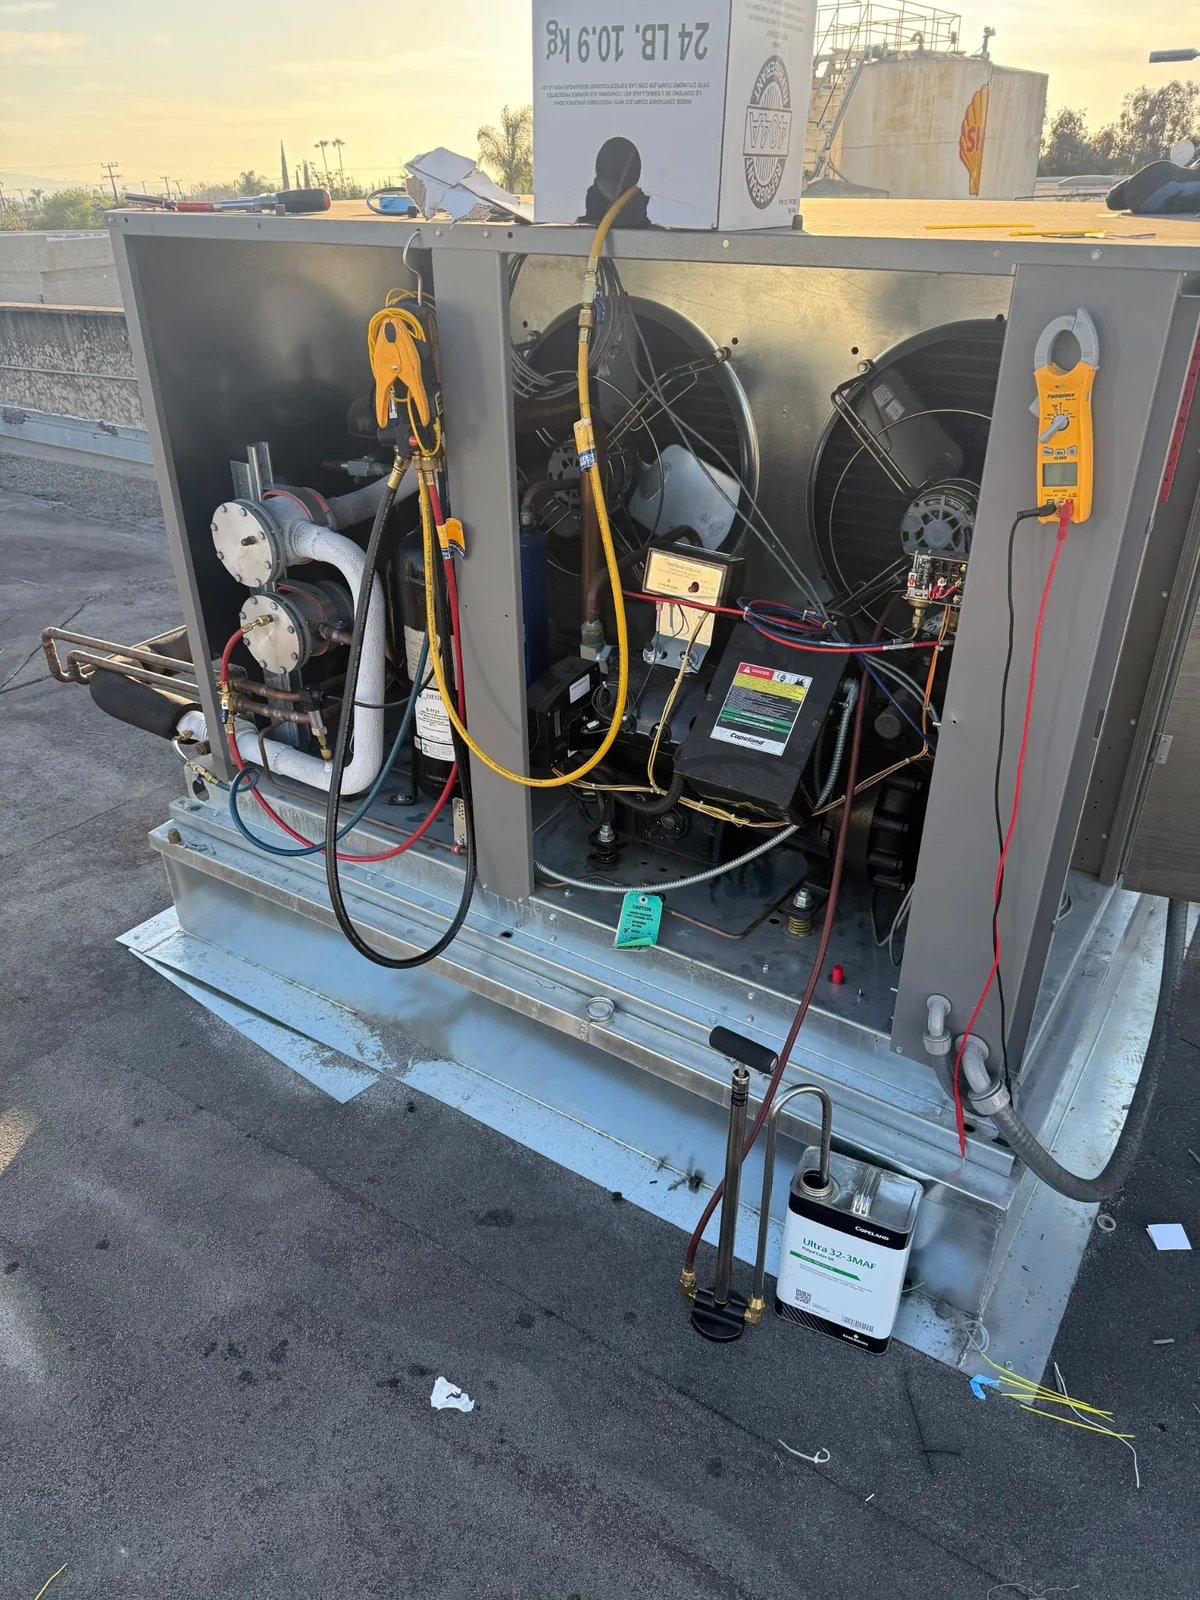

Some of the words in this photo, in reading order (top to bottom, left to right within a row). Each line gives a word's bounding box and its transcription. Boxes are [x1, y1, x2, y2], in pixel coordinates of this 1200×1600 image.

[546, 19, 570, 64] kg
[577, 25, 625, 63] 10.9
[635, 23, 670, 61] LB.
[678, 22, 710, 61] 24
[753, 60, 789, 105] REFRIGERANT
[749, 111, 788, 150] 404A
[745, 158, 782, 204] REFRIGERANT
[1047, 392, 1075, 400] Fieldpiece
[751, 668, 770, 676] DANGER
[730, 732, 765, 746] Copeland
[632, 904, 652, 912] CAUTION
[855, 1225, 890, 1241] COPELAND
[803, 1237, 828, 1253] Ultra
[828, 1247, 878, 1270] 32-3MAF
[842, 1333, 869, 1347] EMERSON
